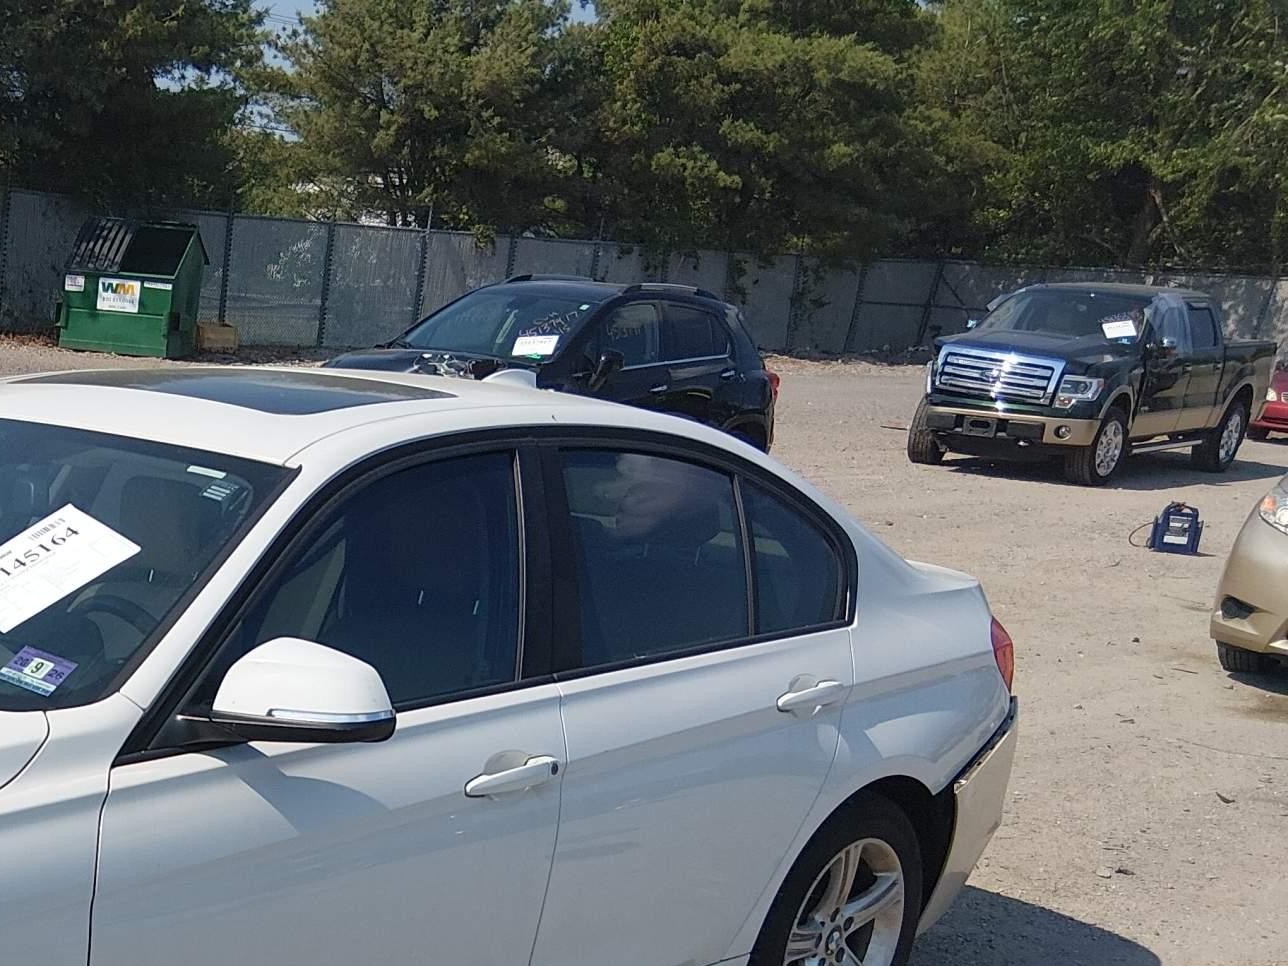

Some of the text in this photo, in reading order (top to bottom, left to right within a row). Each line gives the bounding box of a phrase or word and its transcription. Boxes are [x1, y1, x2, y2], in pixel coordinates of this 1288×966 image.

[101, 281, 136, 296] WM
[31, 661, 45, 674] 9
[48, 668, 65, 680] 26
